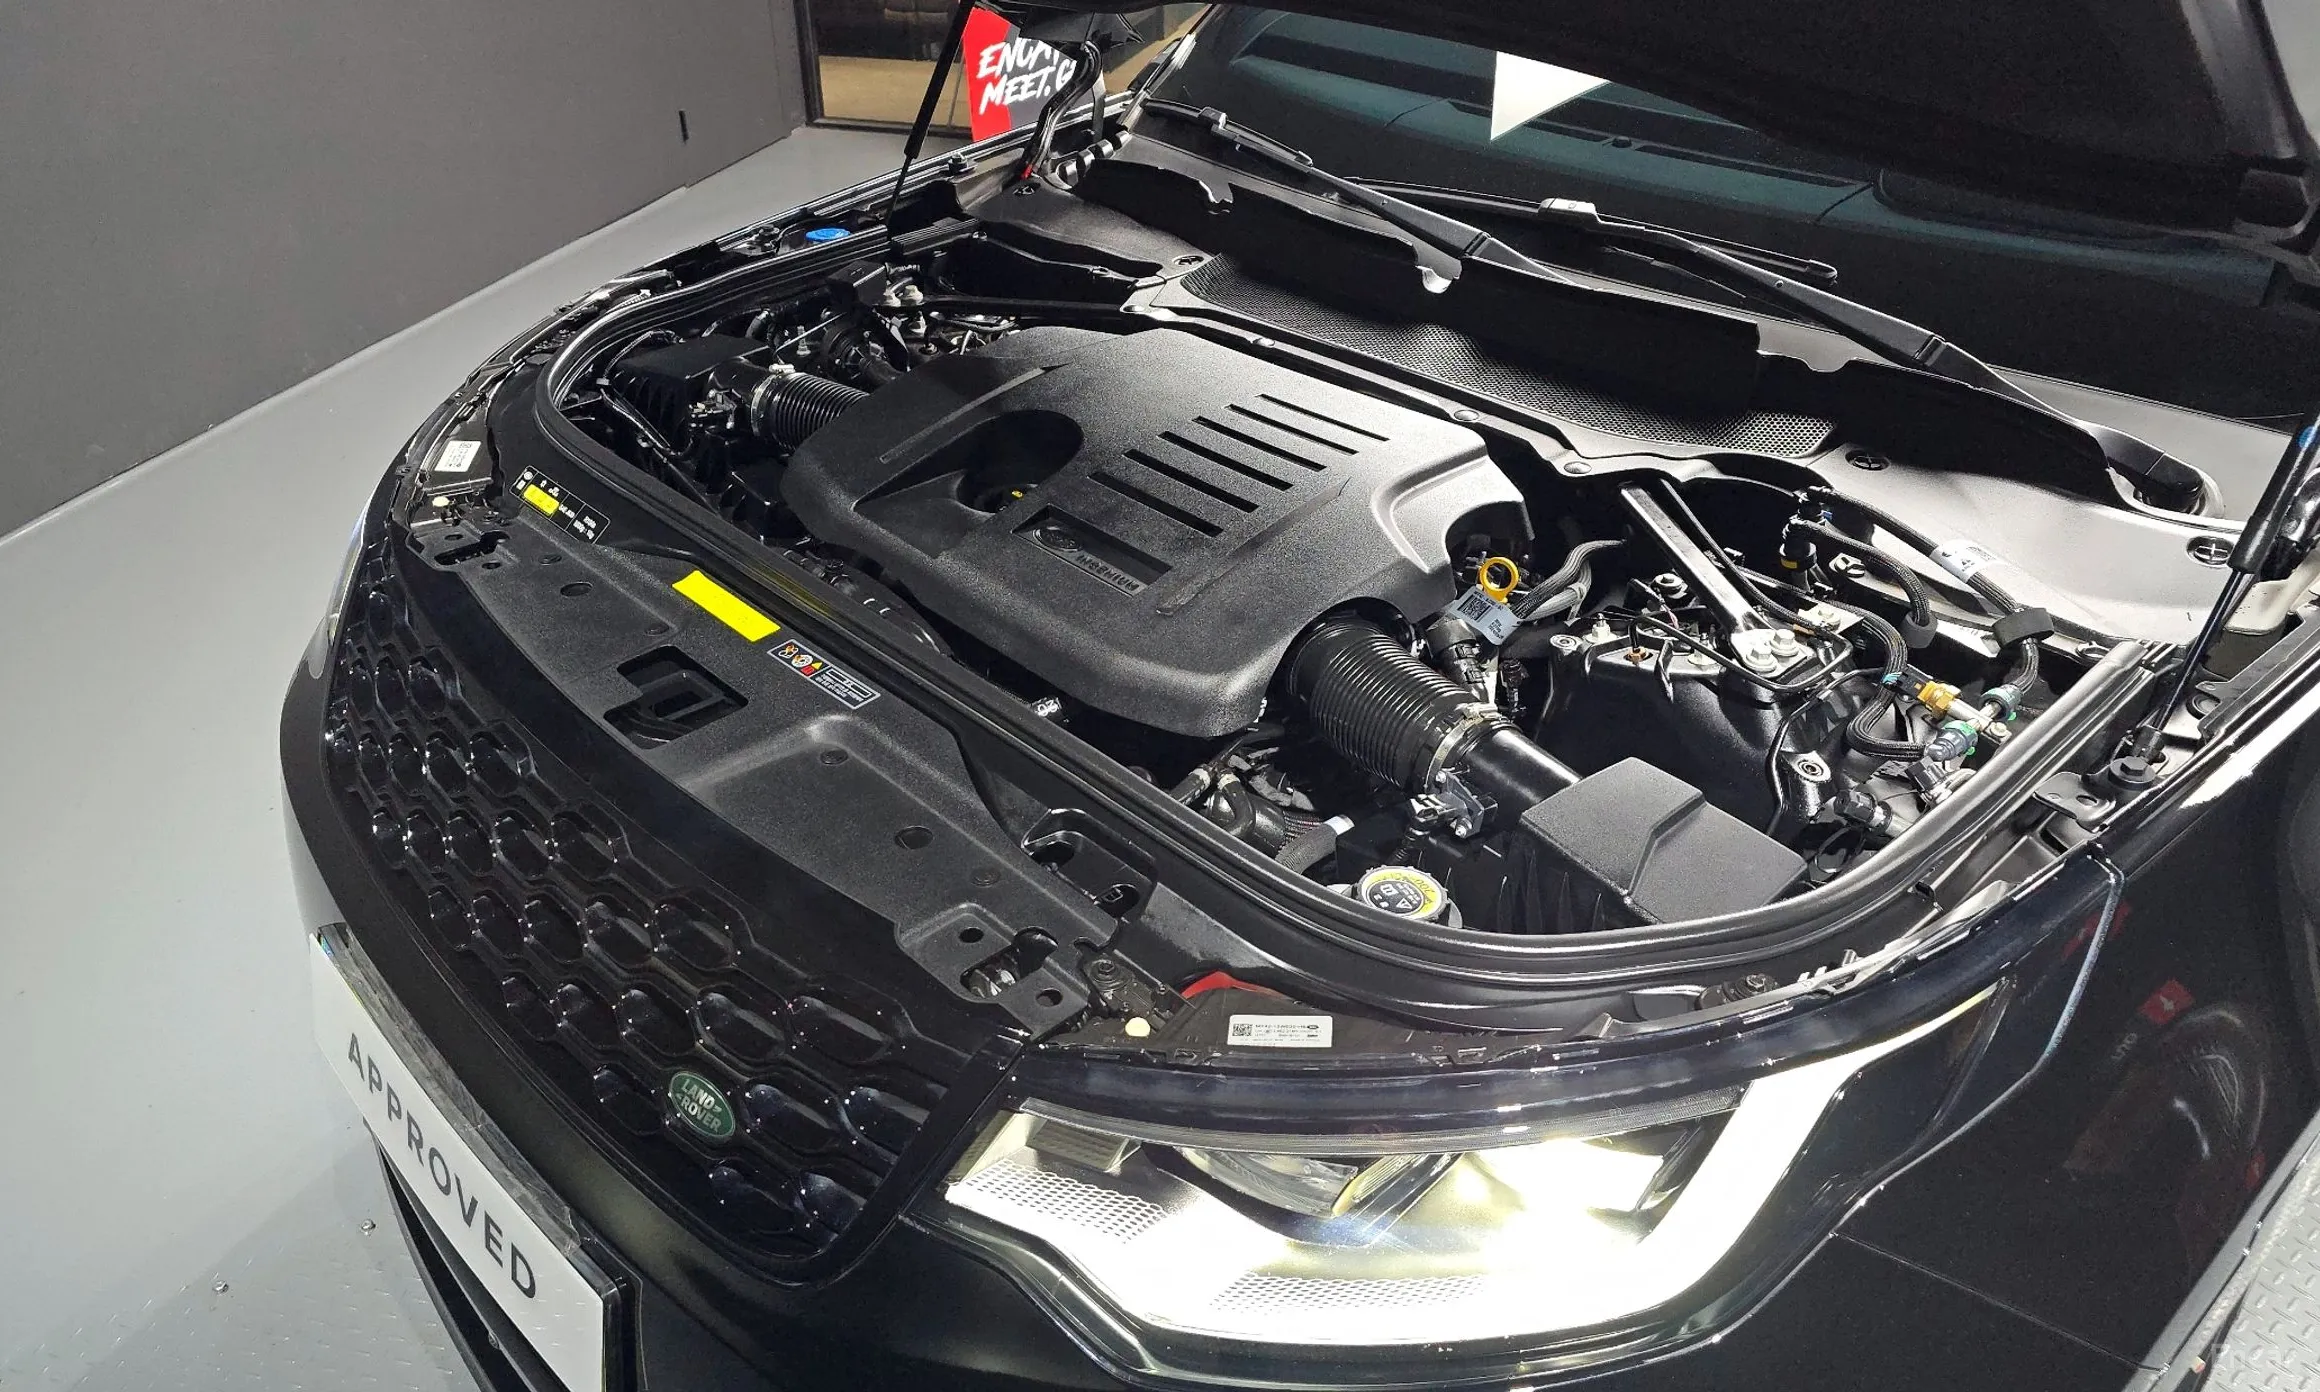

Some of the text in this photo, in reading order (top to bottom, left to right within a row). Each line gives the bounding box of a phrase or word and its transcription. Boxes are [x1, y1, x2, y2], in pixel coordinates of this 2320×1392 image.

[976, 37, 1060, 79] ENCA
[681, 1078, 715, 1110] LAND
[681, 1096, 722, 1133] ROVER
[347, 1031, 537, 1299] APPROVED
